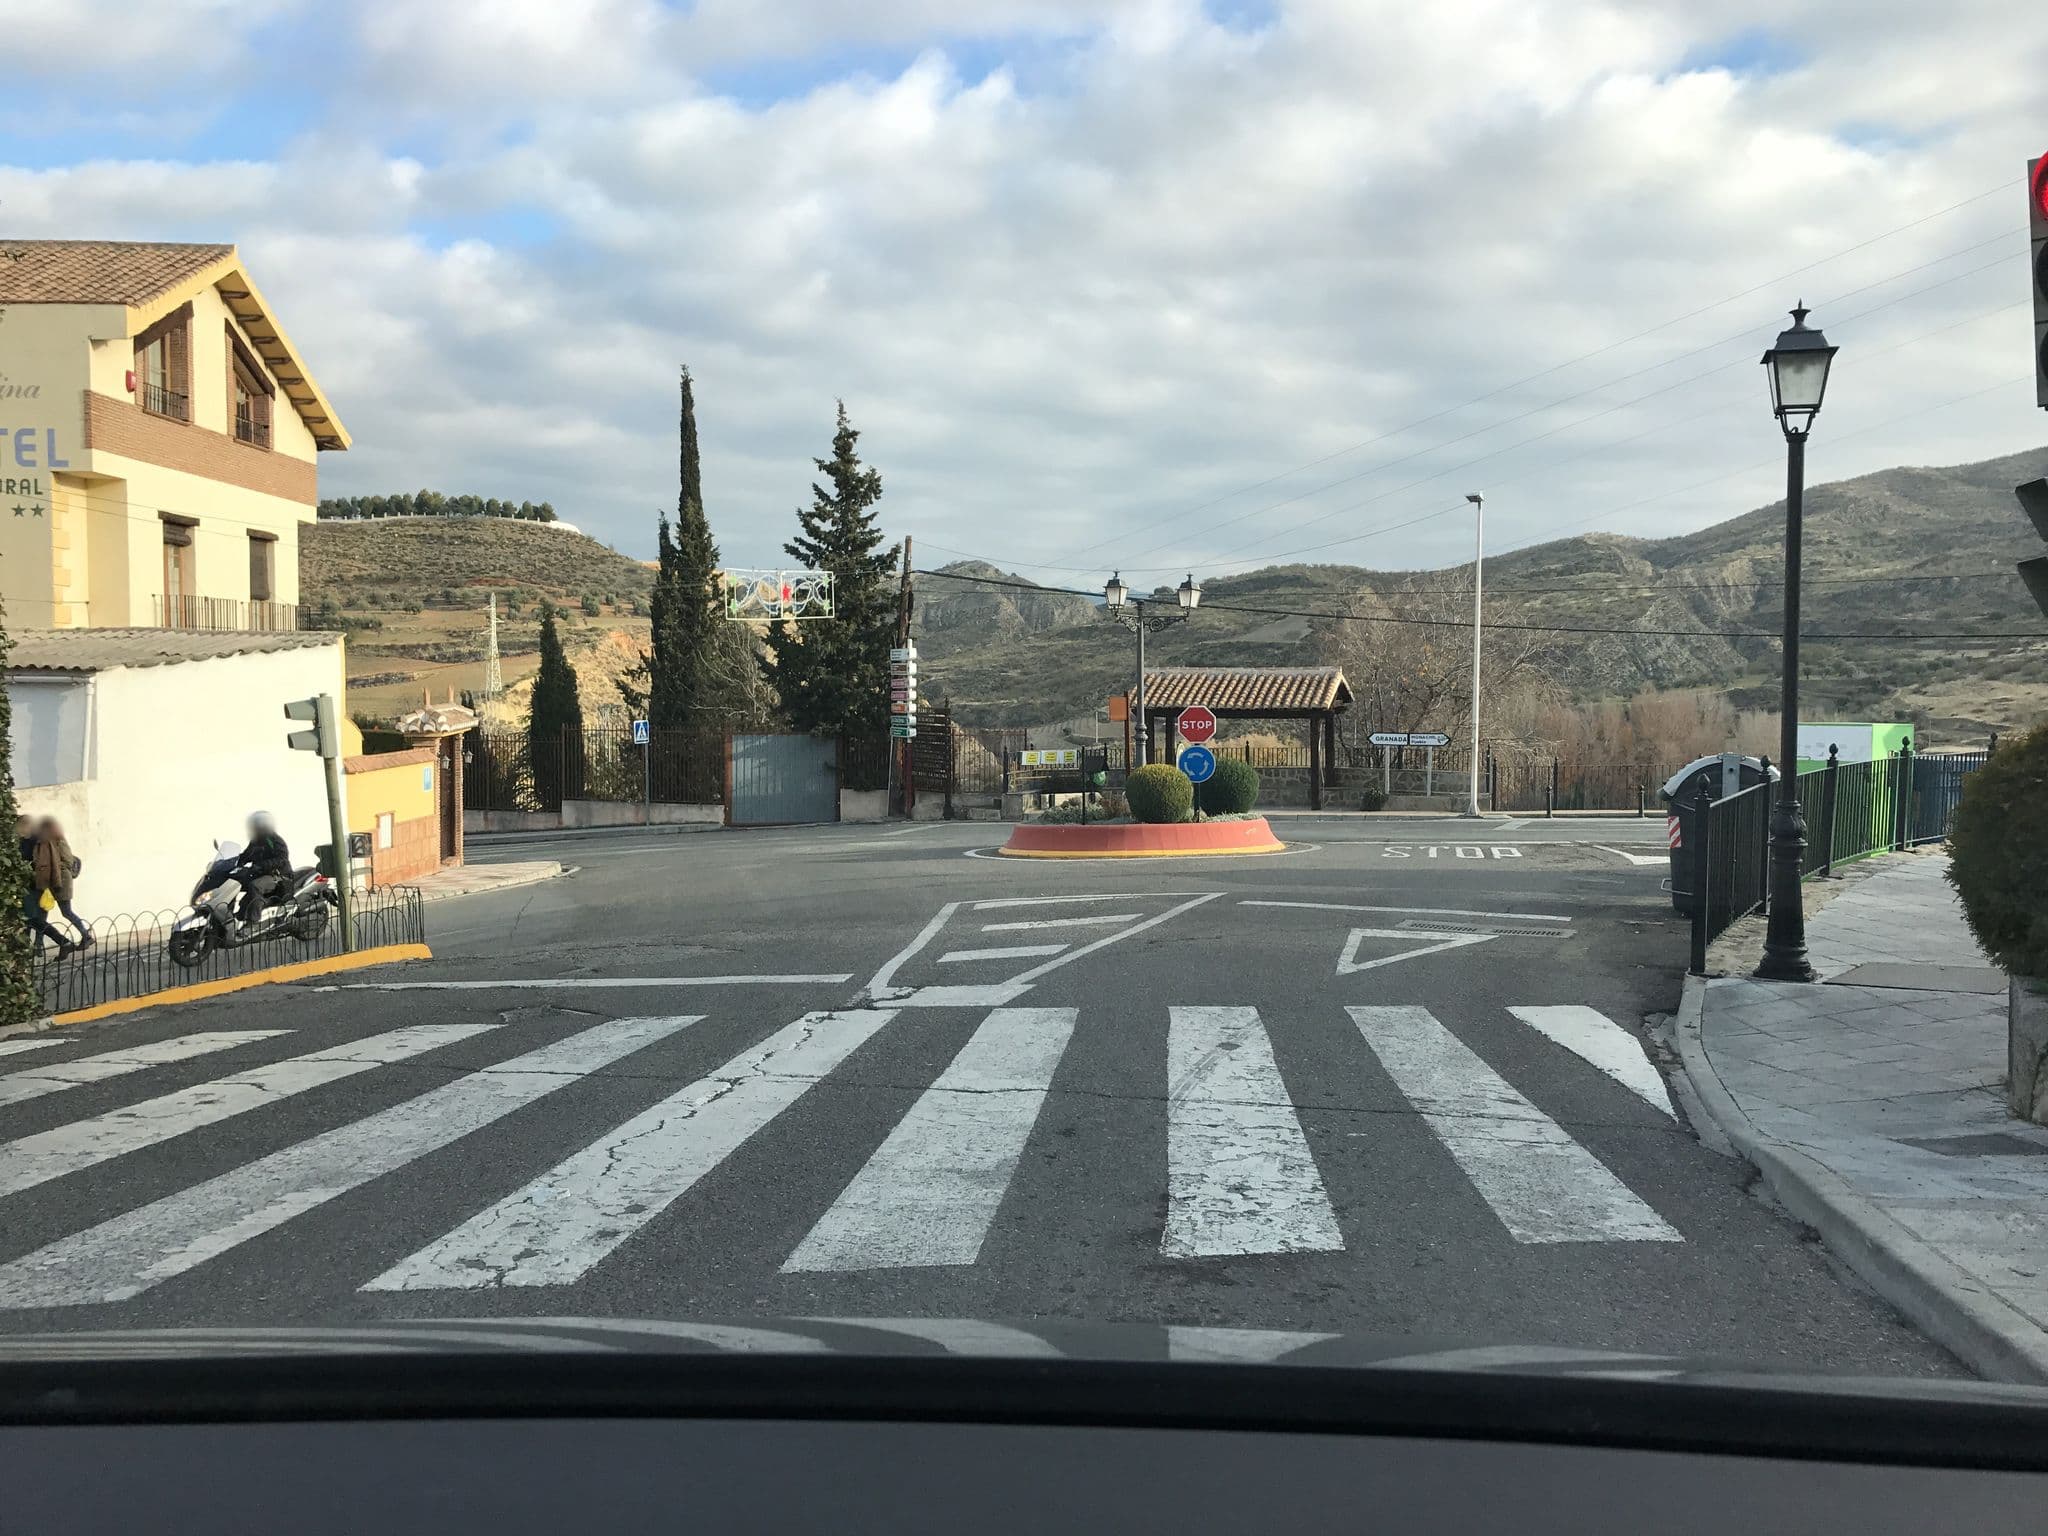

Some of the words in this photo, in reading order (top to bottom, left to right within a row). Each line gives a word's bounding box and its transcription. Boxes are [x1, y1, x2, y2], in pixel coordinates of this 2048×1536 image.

[0, 372, 41, 398] ina
[0, 478, 43, 495] RAL
[1182, 720, 1212, 729] STOP
[1381, 845, 1523, 859] STOP
